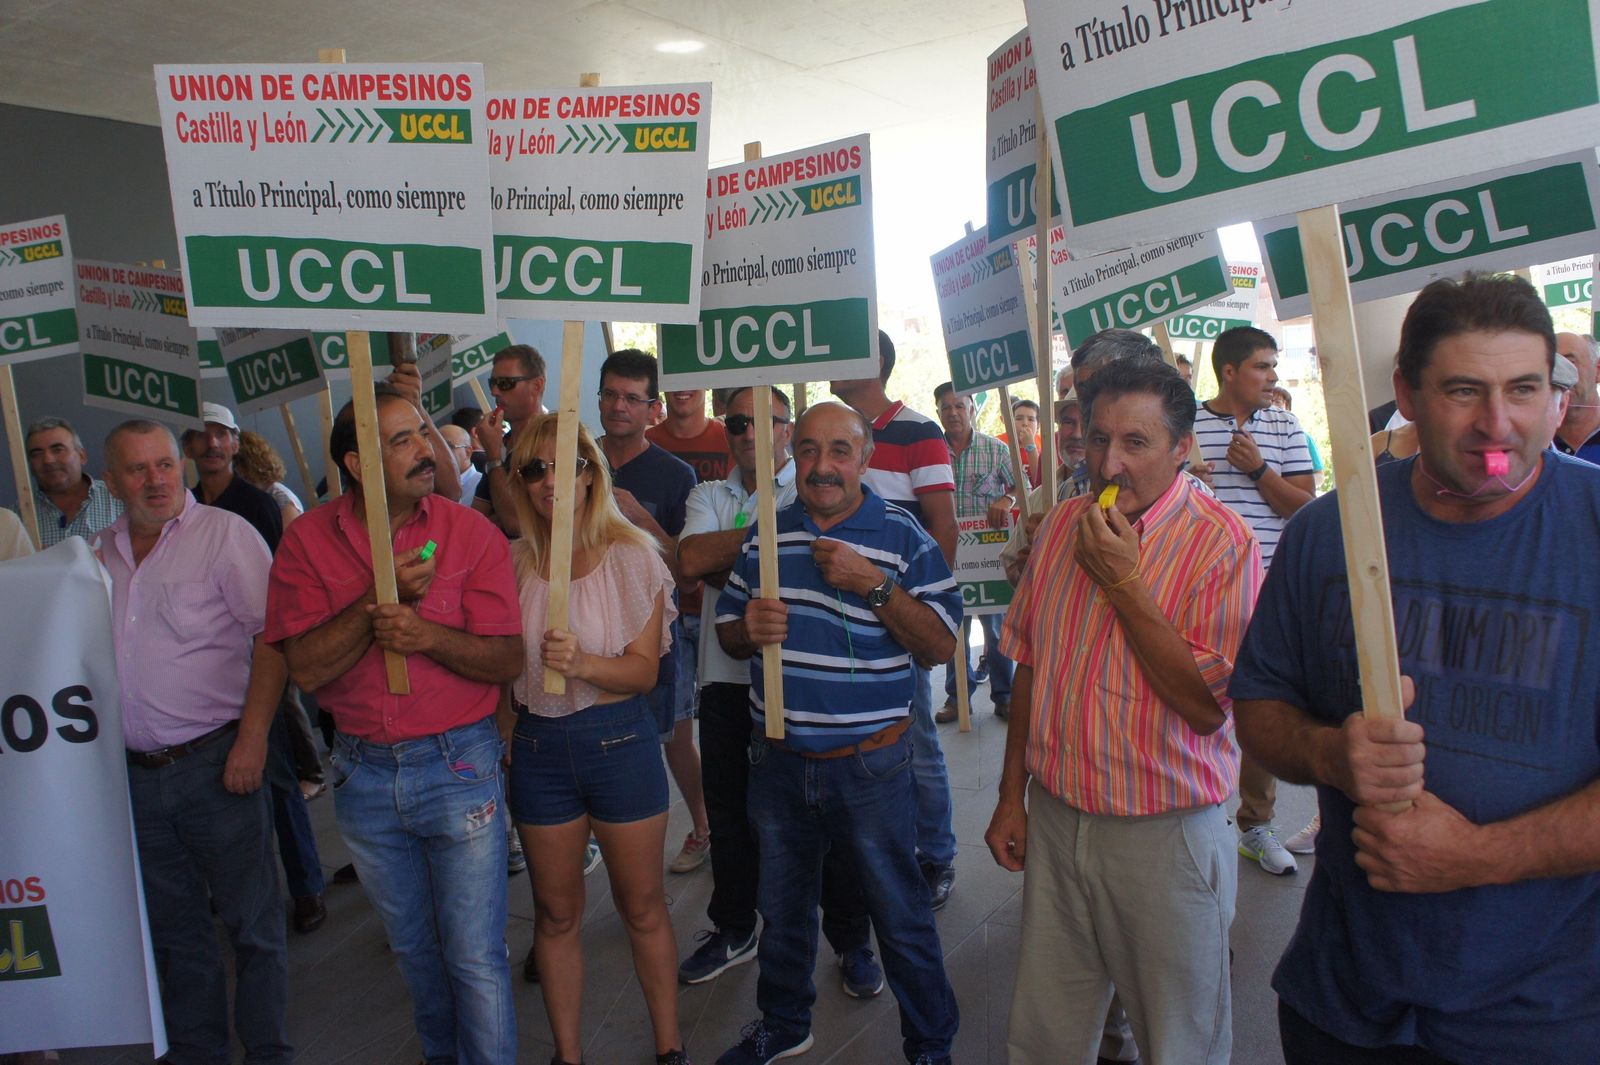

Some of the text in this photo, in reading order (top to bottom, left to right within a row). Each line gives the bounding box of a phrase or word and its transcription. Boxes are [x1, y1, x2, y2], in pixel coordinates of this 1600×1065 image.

[1060, 0, 1291, 71] a Título Princip
[991, 41, 1022, 82] UNION
[169, 74, 472, 101] UNION DE CAMPESINOS
[523, 97, 550, 119] DE
[557, 92, 700, 119] CAMPESINOS
[991, 74, 1015, 113] Castilla
[1017, 77, 1022, 101] y
[175, 110, 307, 151] Castilla y León
[399, 113, 465, 140] UCCL
[1130, 35, 1476, 194] UCCL
[487, 127, 555, 161] la y León
[634, 126, 689, 150] UCCL
[997, 128, 1018, 158] Título
[718, 173, 739, 197] DE
[744, 145, 861, 191] CAMPESINOS
[193, 181, 466, 217] a Título Principal, como siempre
[507, 186, 575, 217] Principal,
[579, 192, 619, 211] como
[623, 186, 684, 217] siempre
[810, 181, 855, 212] UCCL
[0, 223, 61, 246] PESINOS
[718, 201, 746, 231] León
[24, 243, 60, 262] UCCL
[713, 254, 768, 287] Principal,
[771, 256, 804, 276] como
[807, 246, 857, 274] siempre
[25, 281, 64, 297] siempre
[78, 263, 110, 282] UNION
[112, 267, 125, 285] DE
[238, 248, 431, 305] UCCL
[1063, 285, 1070, 297] a
[1069, 274, 1096, 294] Título
[1095, 252, 1140, 285] Principal,
[1140, 247, 1165, 265] como
[1090, 275, 1197, 332] UCCL
[696, 308, 830, 366] UCCL
[238, 349, 302, 396] UCCL
[963, 340, 1019, 384] UCCL
[104, 363, 179, 409] UCCL
[982, 532, 1007, 543] UCCL
[962, 561, 979, 571] como
[0, 684, 98, 754] OS
[0, 920, 43, 973] L
